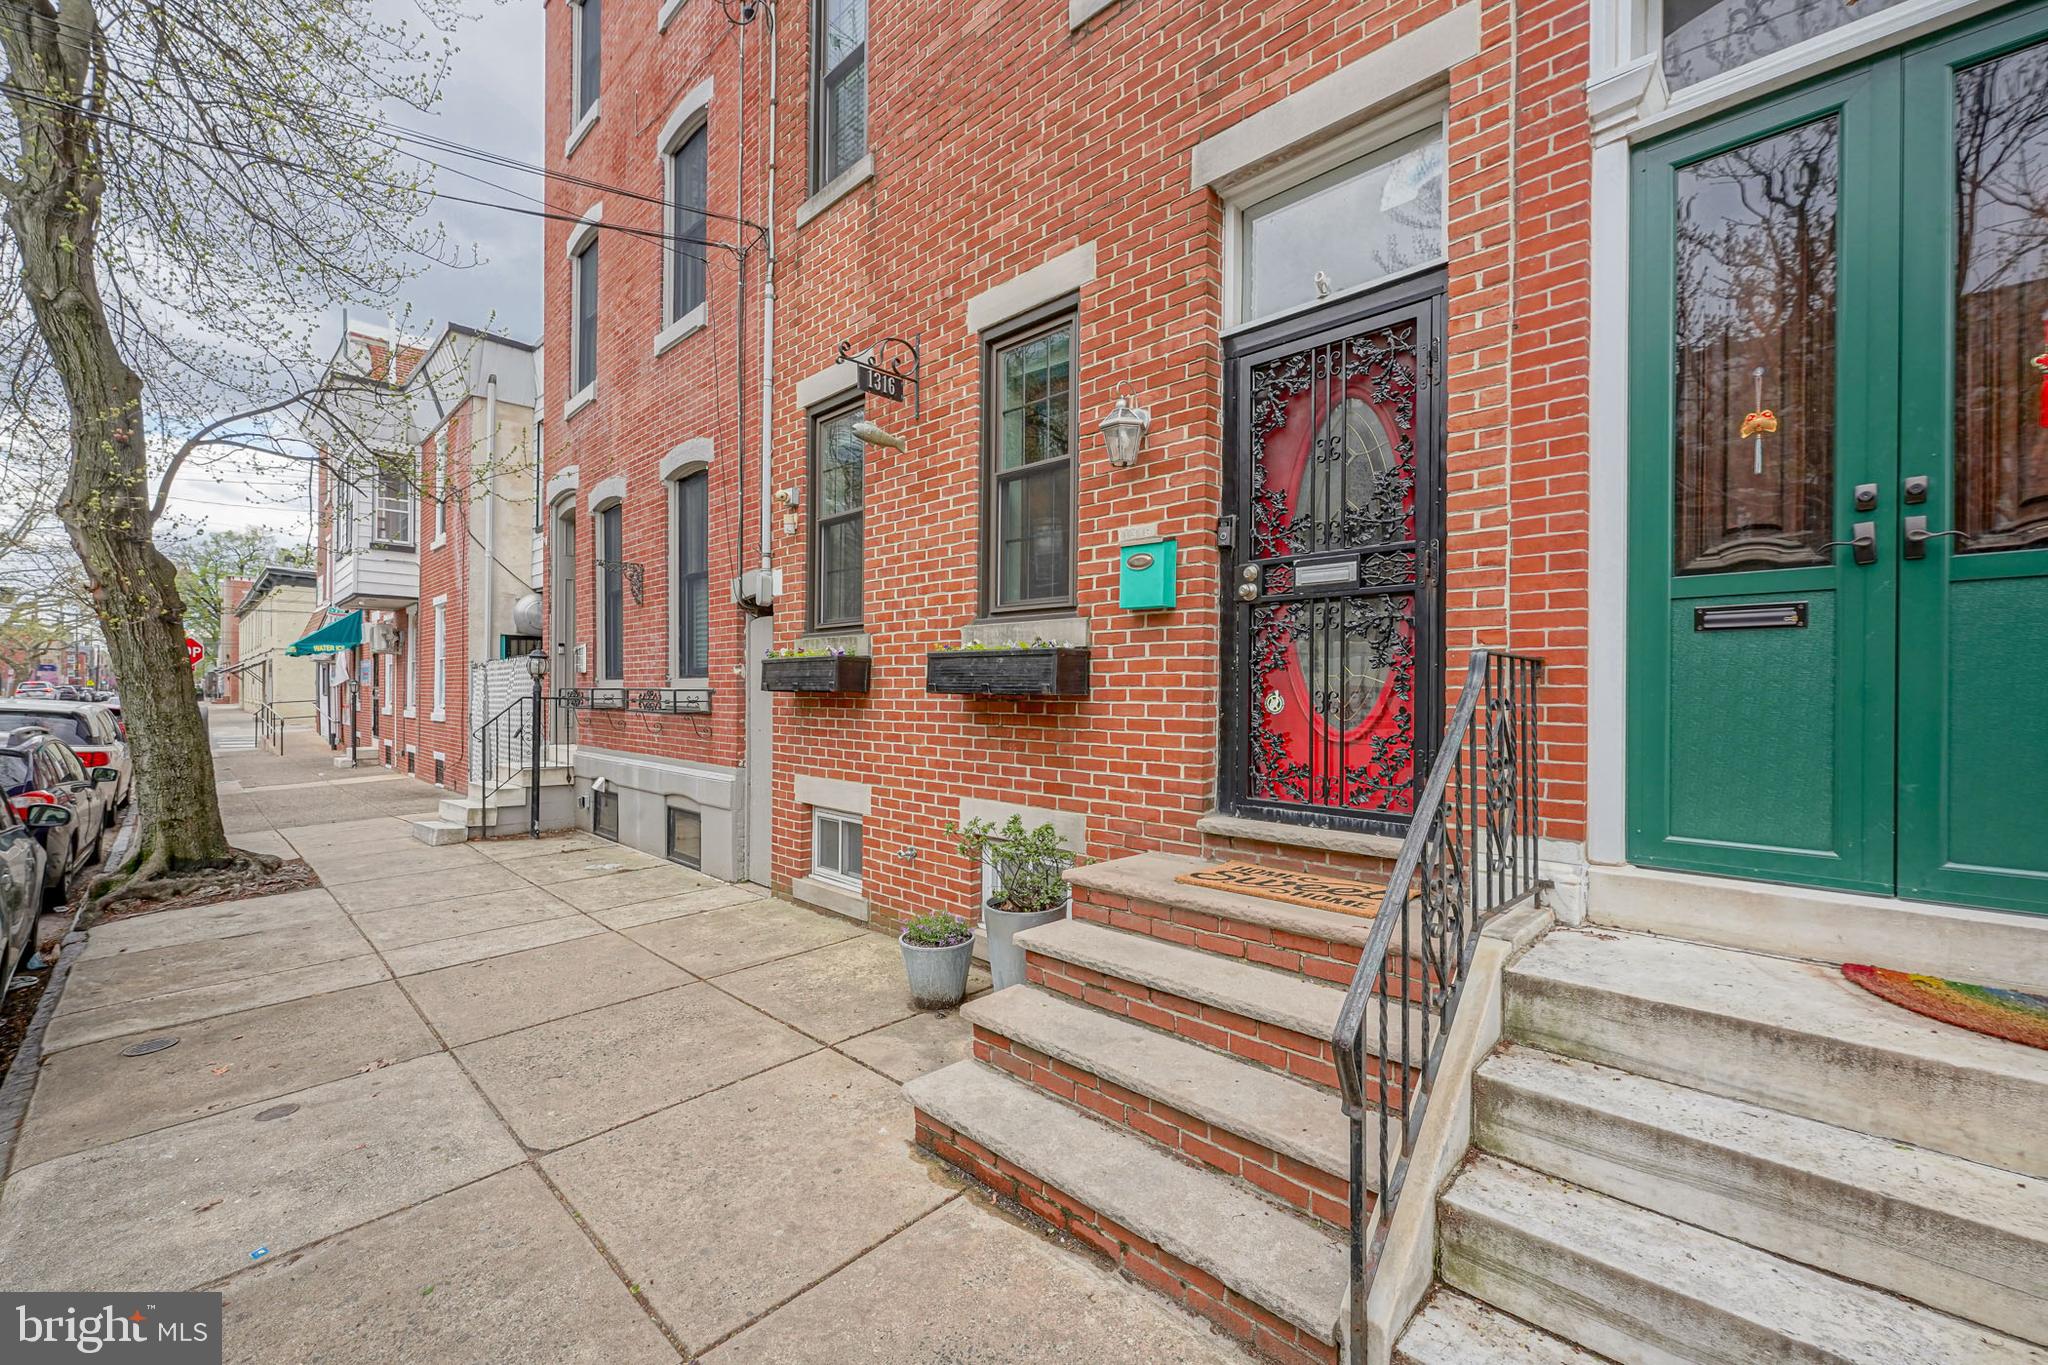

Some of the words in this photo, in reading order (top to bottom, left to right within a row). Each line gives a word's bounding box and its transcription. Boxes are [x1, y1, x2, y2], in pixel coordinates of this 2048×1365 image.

[868, 371, 895, 395] 1316
[1231, 866, 1300, 880] HOME
[1291, 889, 1376, 910] HOME
